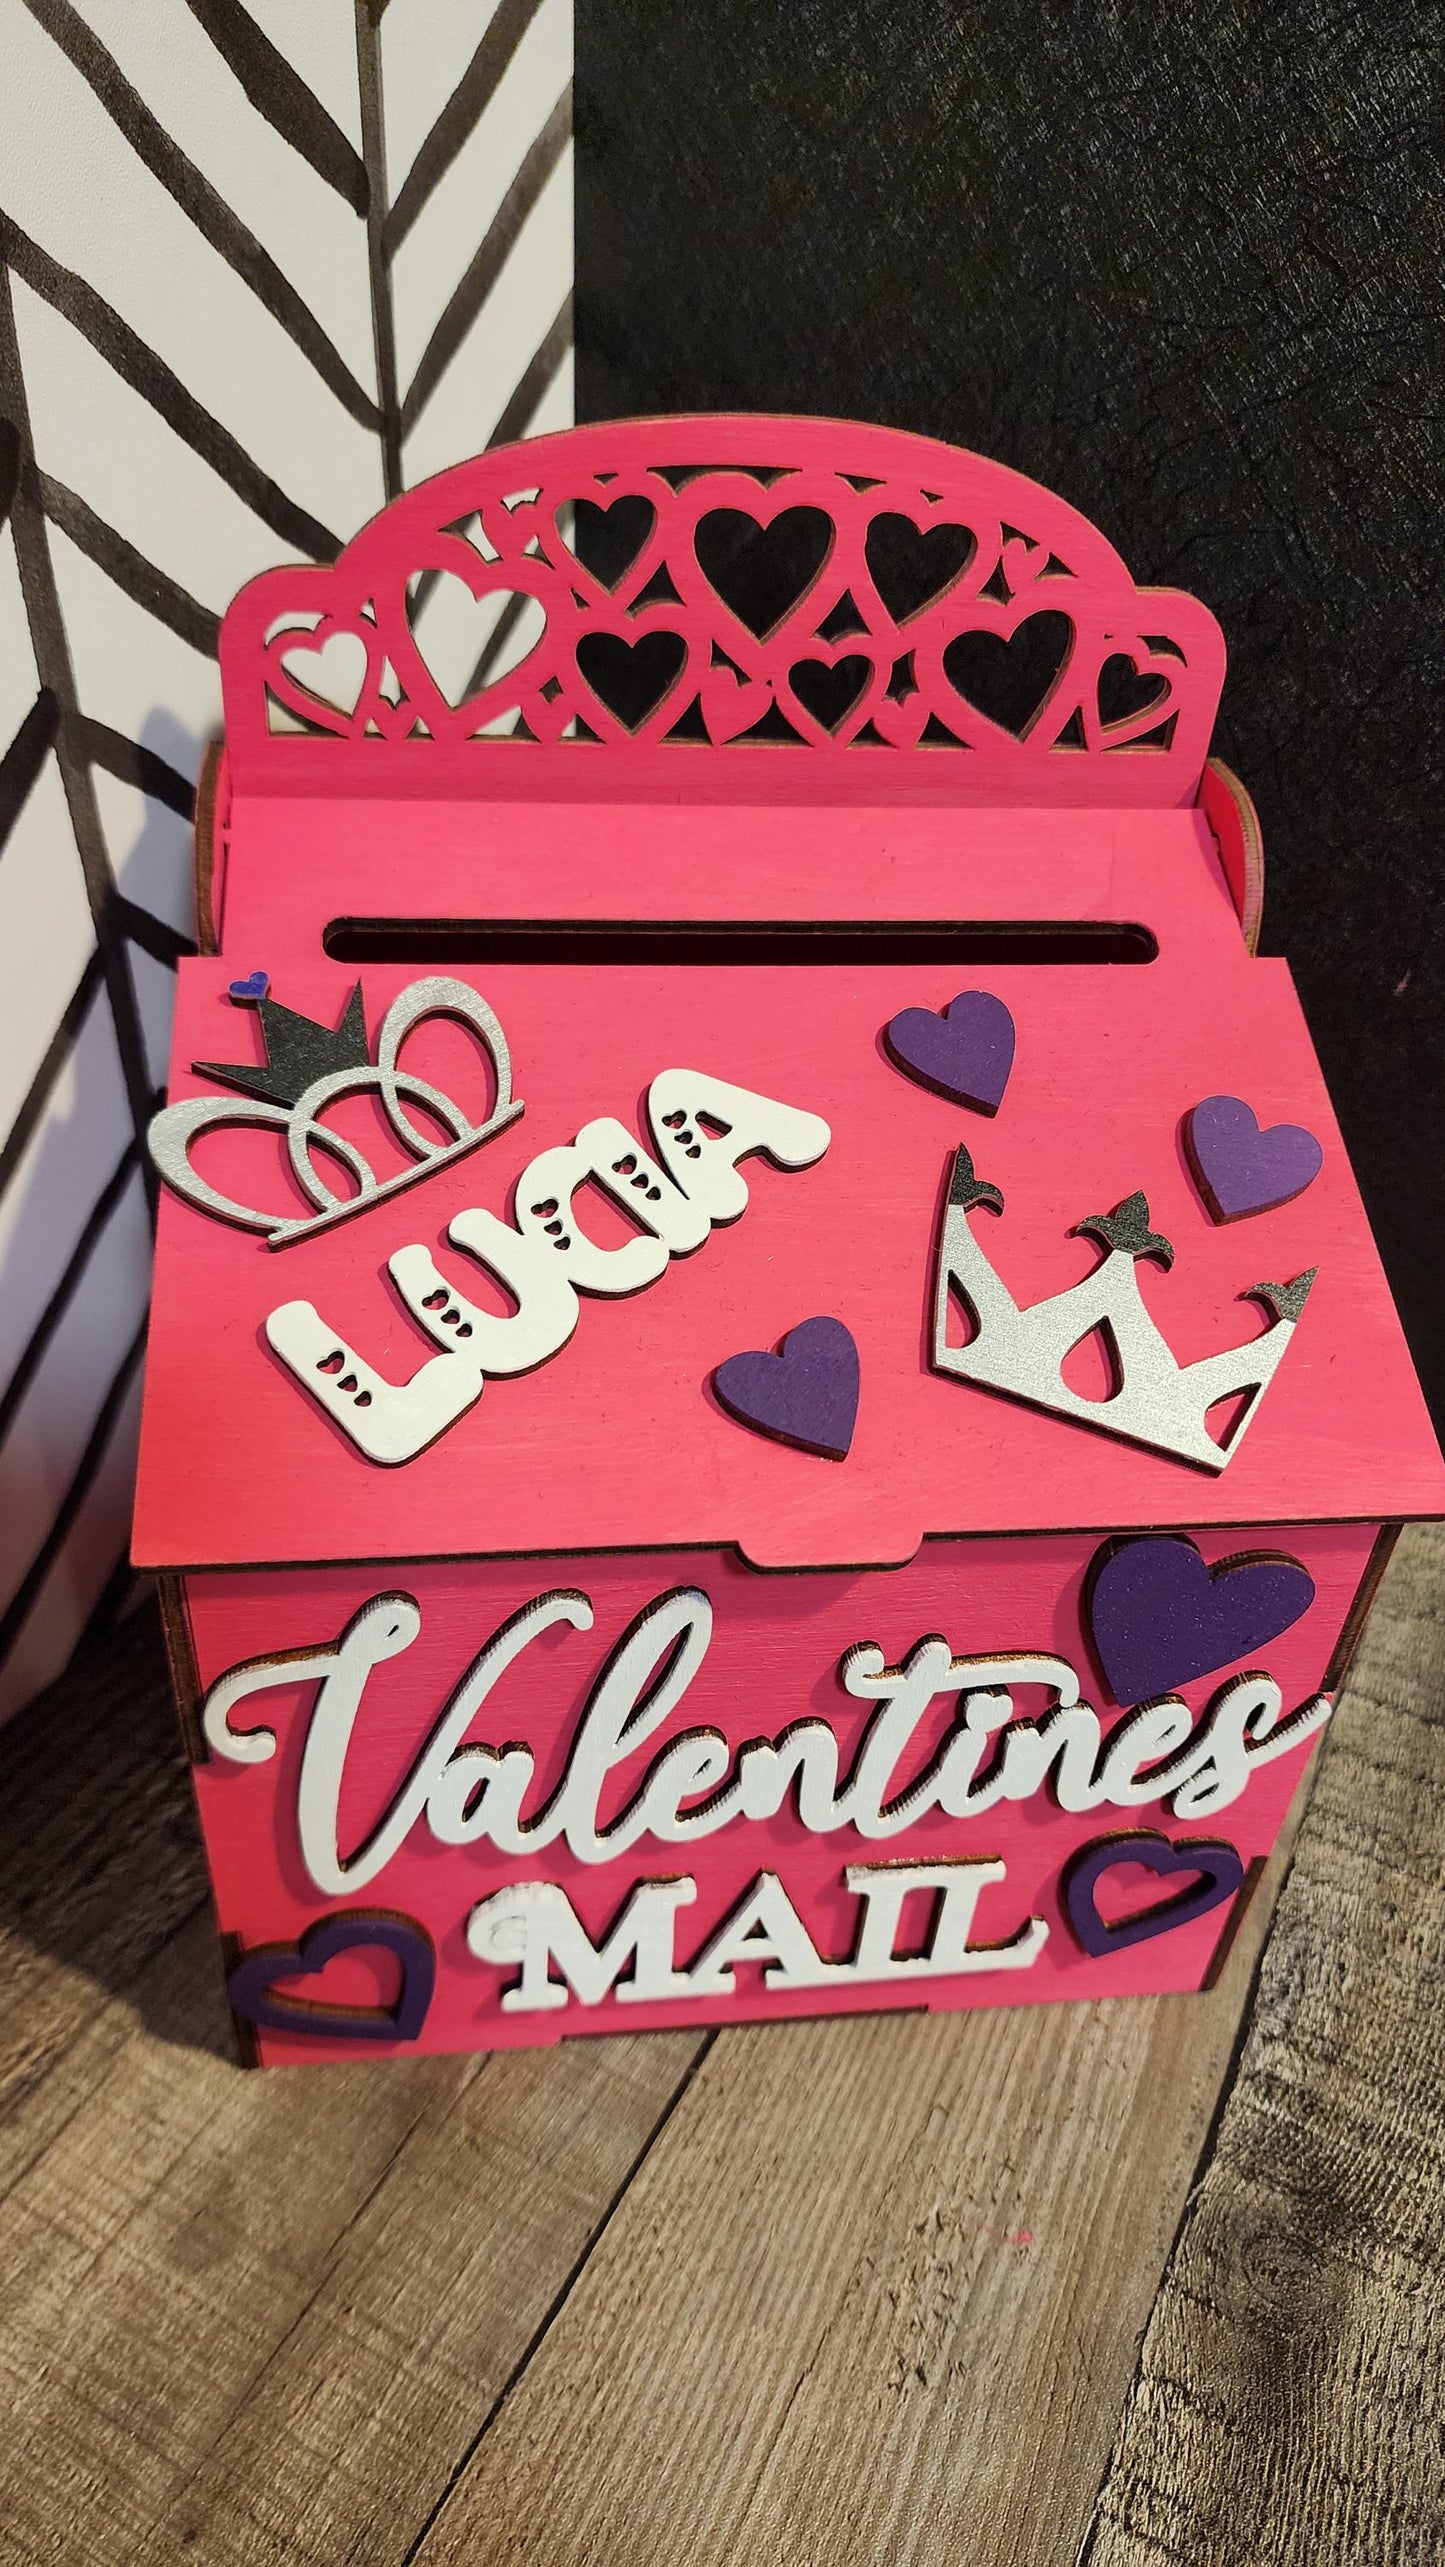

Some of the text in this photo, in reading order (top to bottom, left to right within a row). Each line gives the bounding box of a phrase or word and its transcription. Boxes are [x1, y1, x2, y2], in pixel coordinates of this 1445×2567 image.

[265, 1068, 832, 1466] LUCIA
[203, 1587, 1332, 1896] Valentines
[466, 1855, 1049, 2013] MAIL
